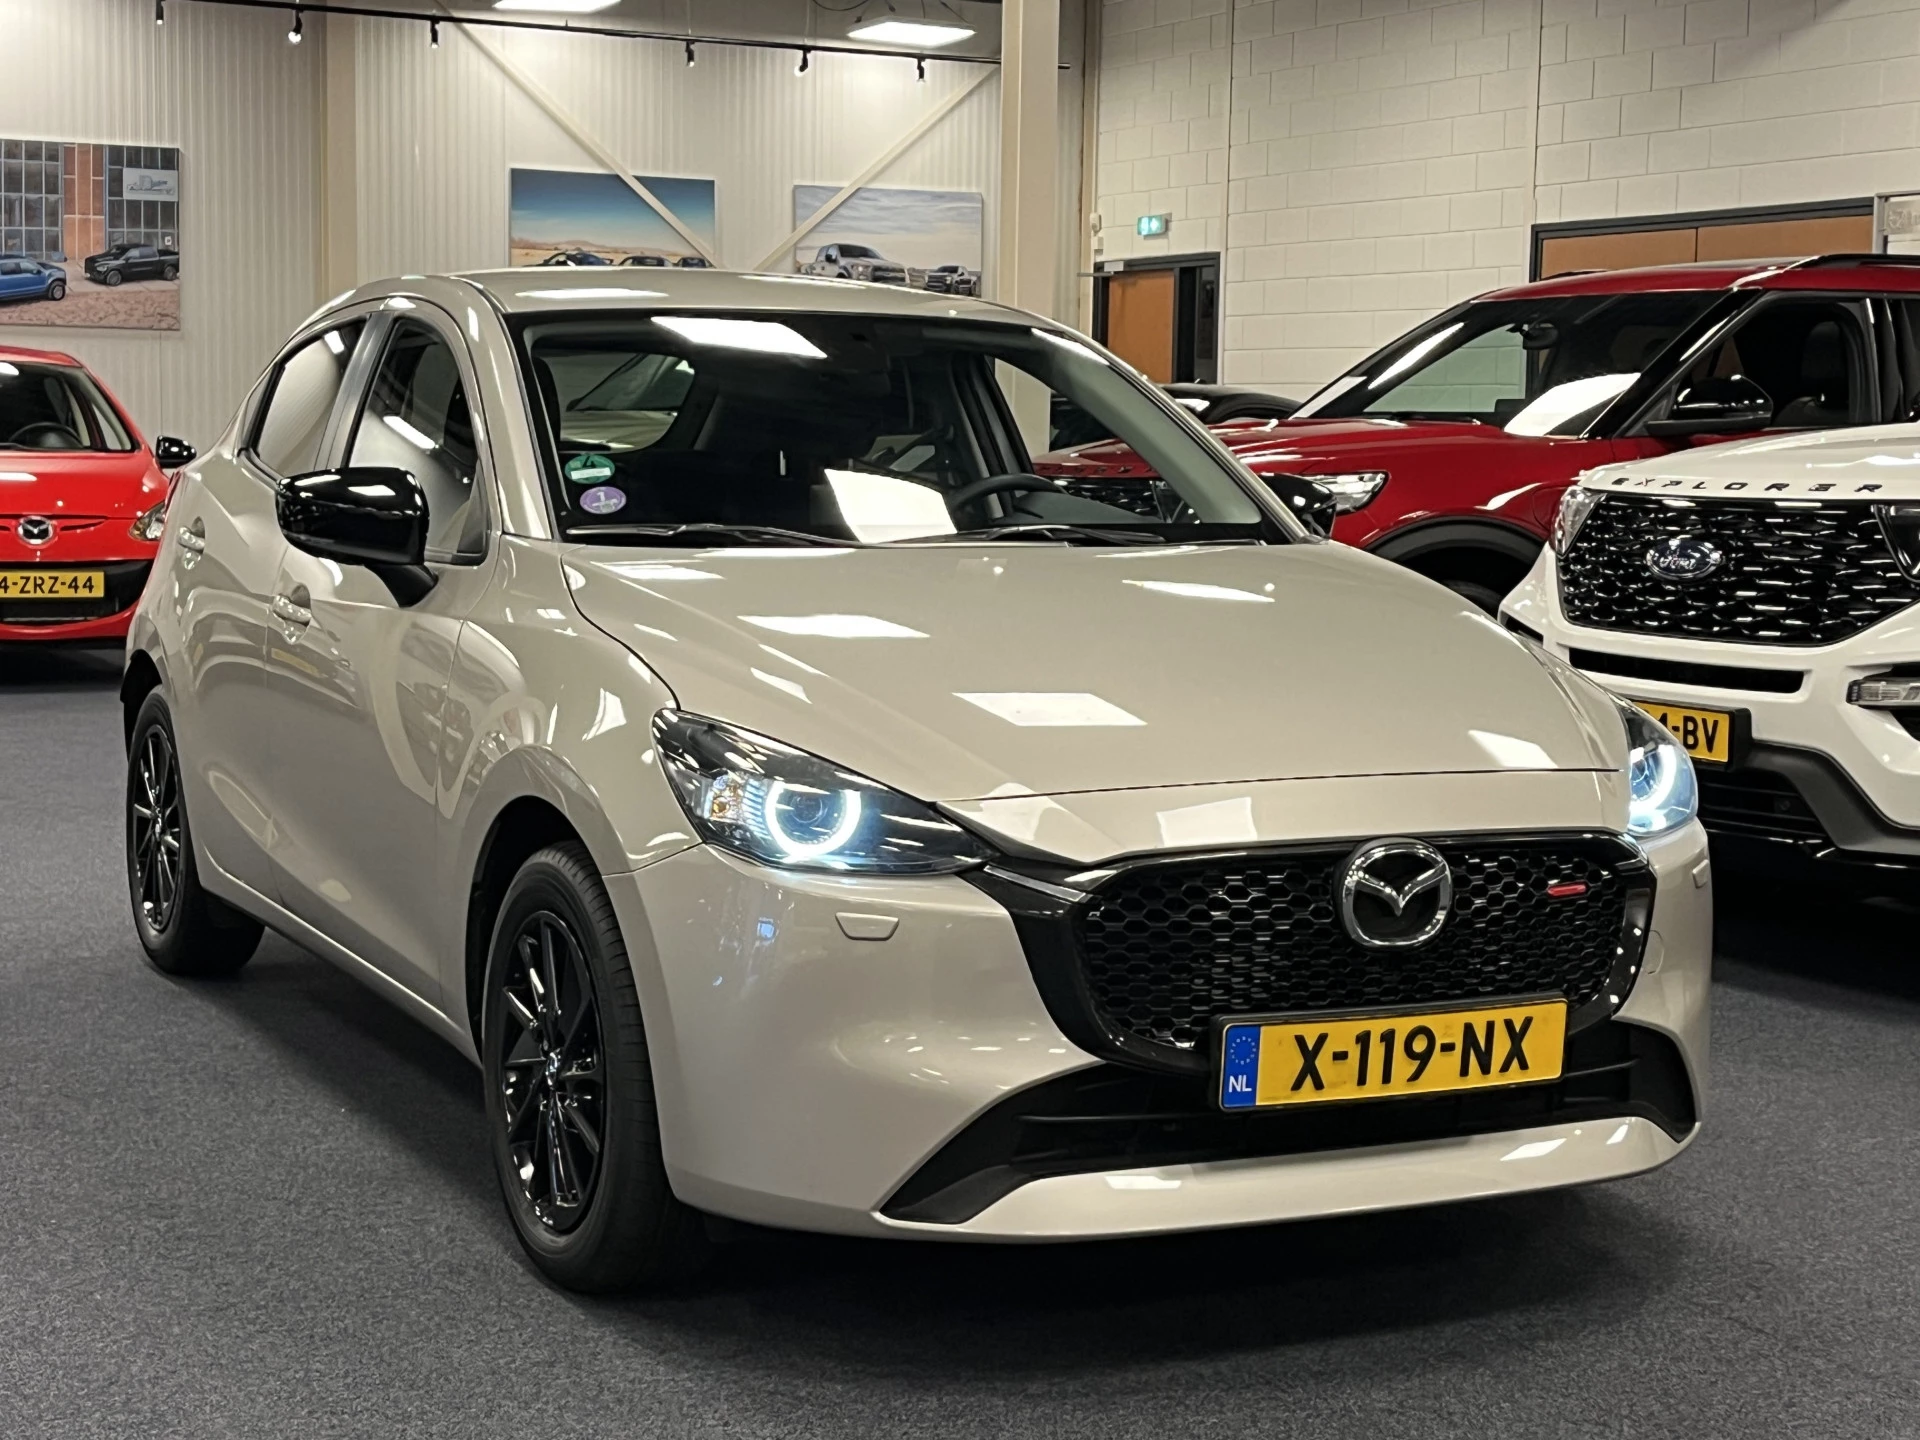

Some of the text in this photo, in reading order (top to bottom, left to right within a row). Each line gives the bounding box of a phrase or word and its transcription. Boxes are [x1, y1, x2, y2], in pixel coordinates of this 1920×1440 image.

[1611, 477, 1883, 493] EXPLORER
[0, 575, 94, 594] 4-ZRZ-44
[1229, 1016, 1533, 1093] NL X-119-NX
